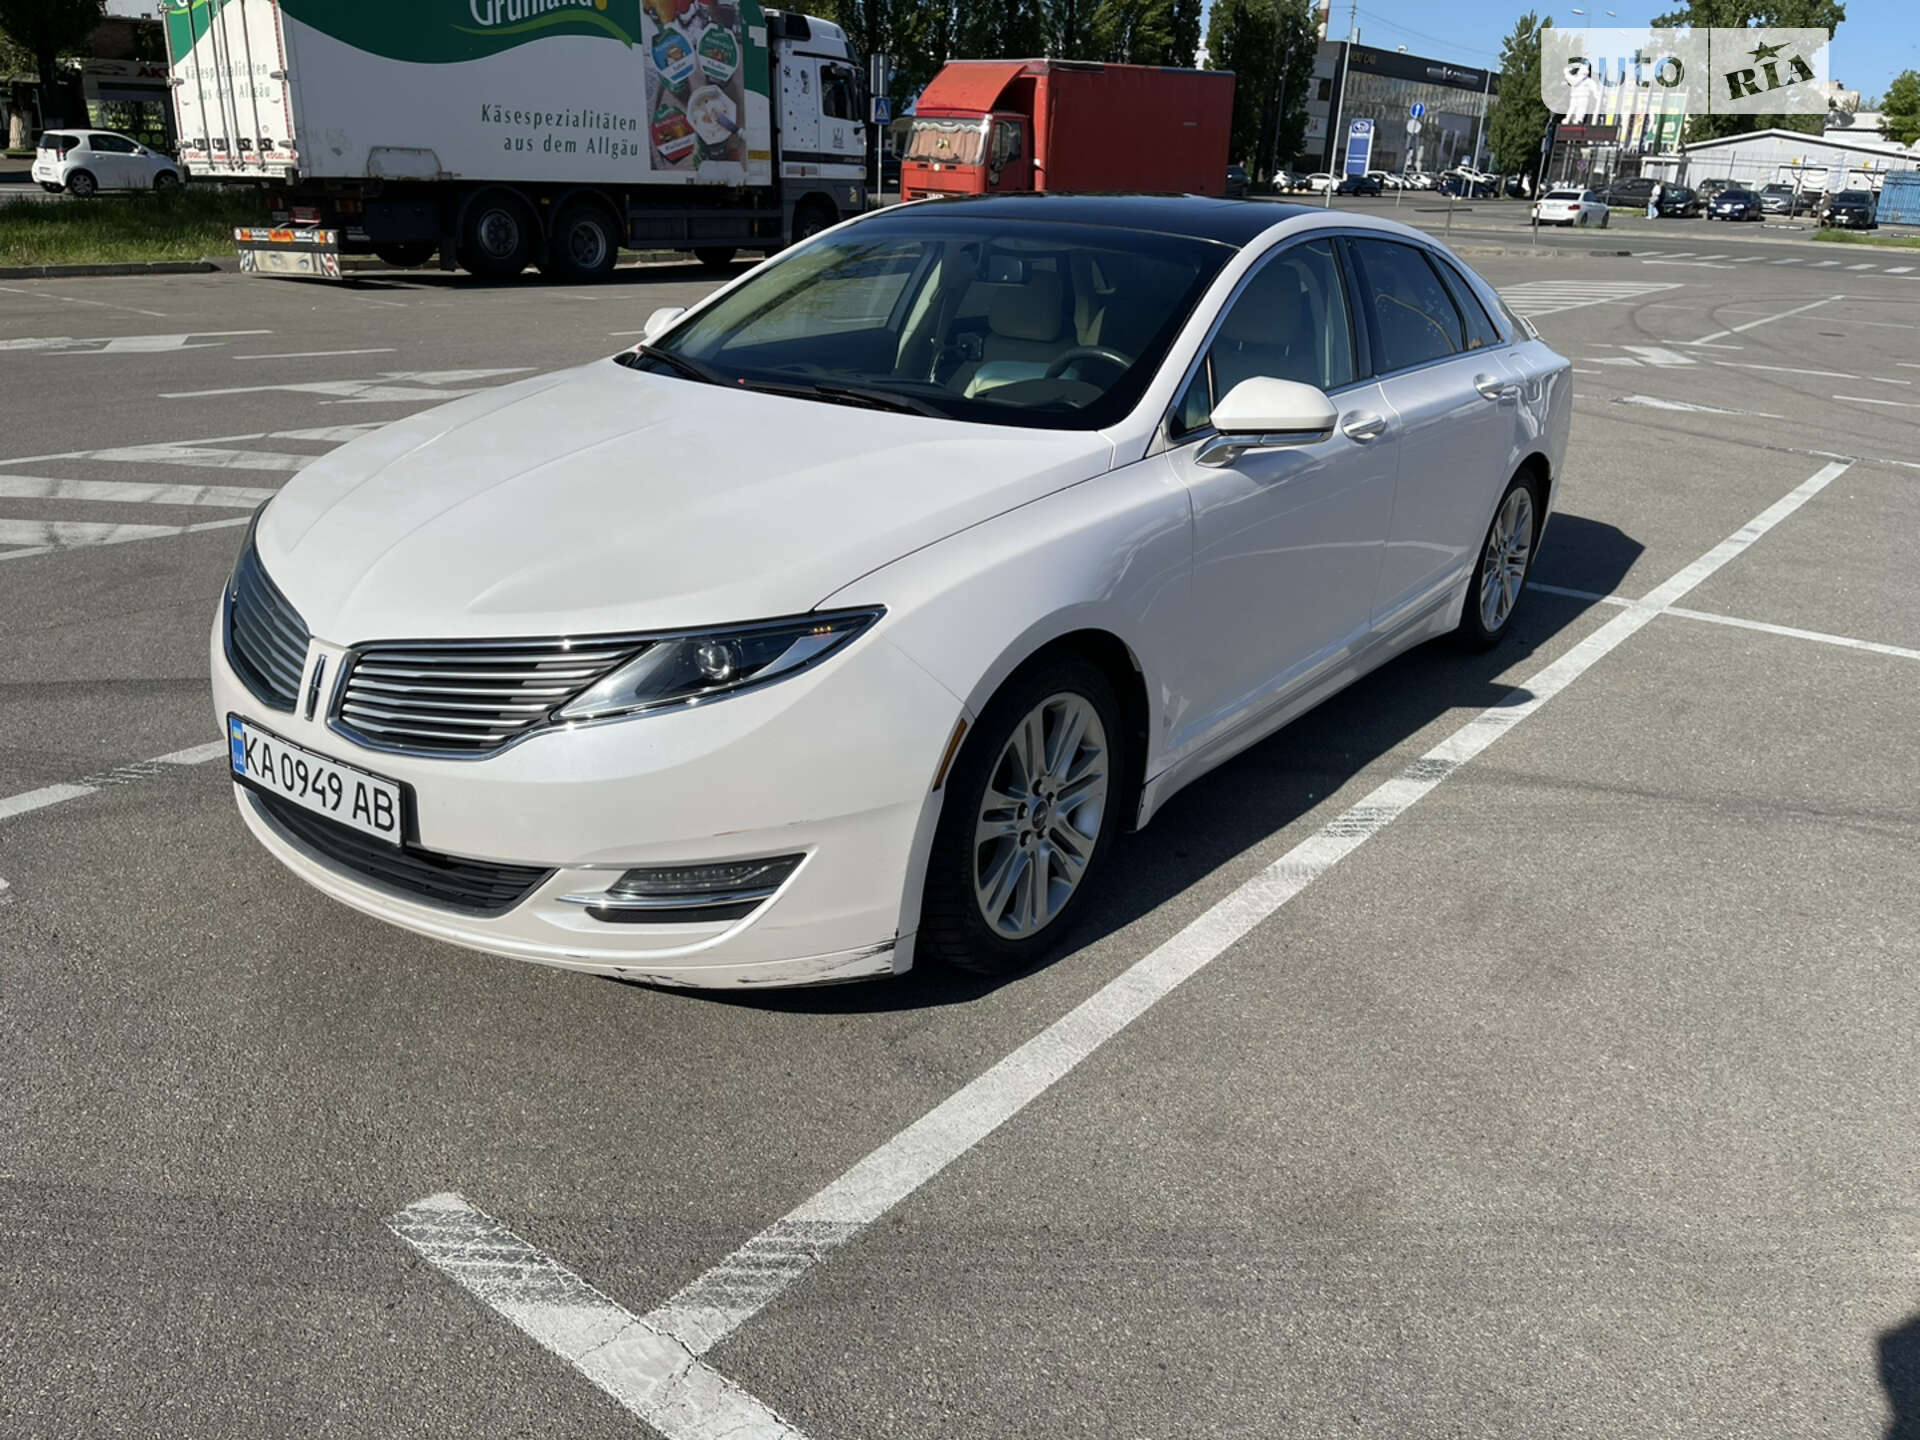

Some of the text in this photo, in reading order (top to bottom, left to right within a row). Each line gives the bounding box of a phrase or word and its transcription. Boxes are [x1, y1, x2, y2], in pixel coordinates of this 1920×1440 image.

[481, 103, 637, 131] Käsespezialitäten
[504, 134, 639, 160] aus dem Allgäu
[243, 731, 395, 832] KA 0949 AB
